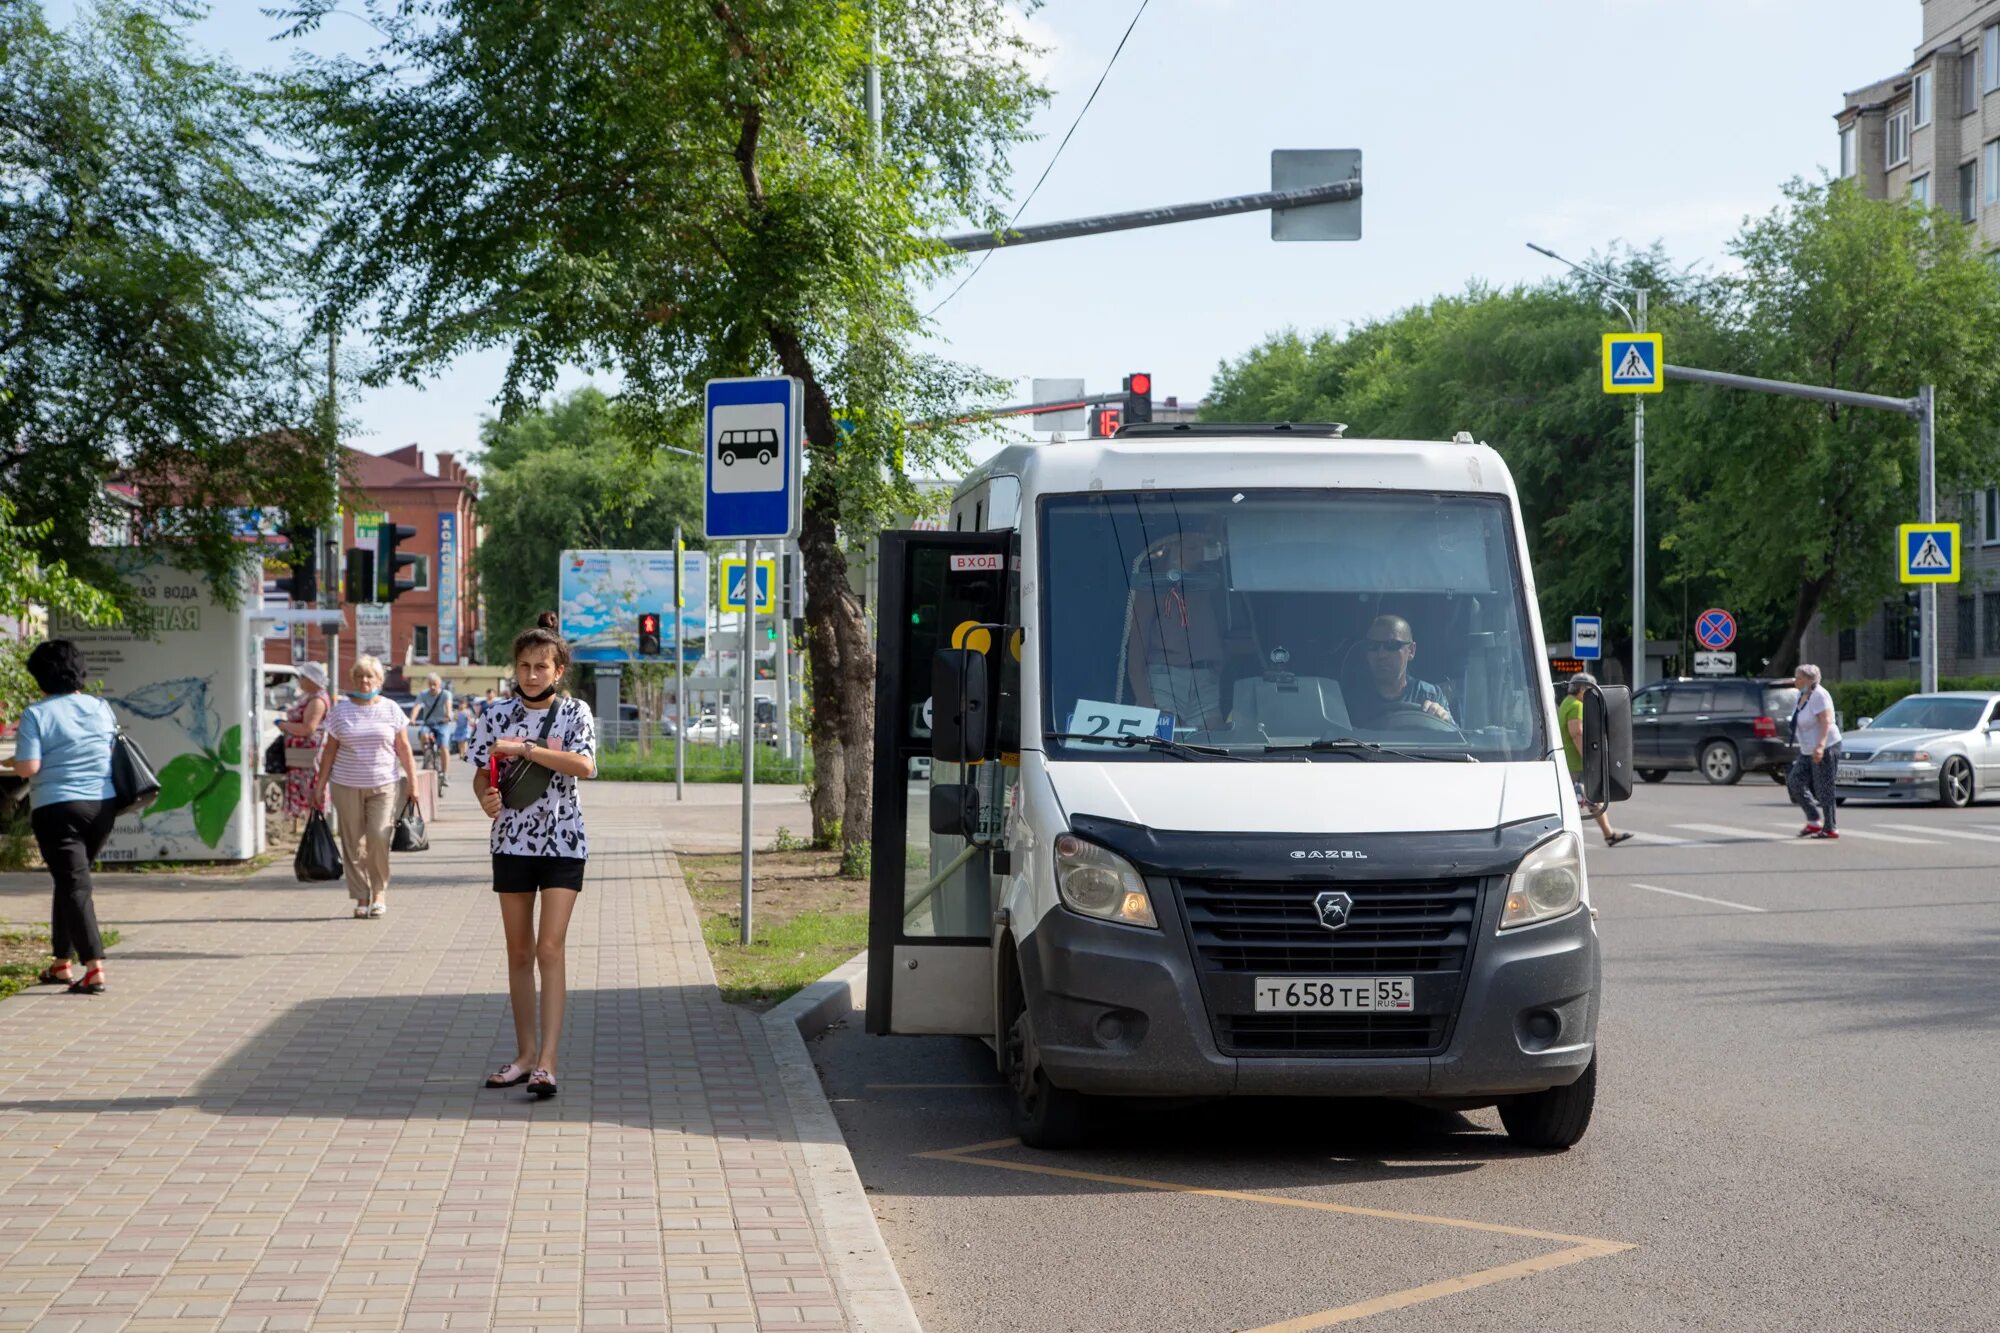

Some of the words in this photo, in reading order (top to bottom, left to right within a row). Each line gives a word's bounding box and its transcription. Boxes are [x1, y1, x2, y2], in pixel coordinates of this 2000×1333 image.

[1100, 410, 1119, 436] 16
[957, 557, 997, 568] ВХОД
[163, 586, 199, 600] ВОДА
[1080, 715, 1142, 748] 25
[1290, 850, 1368, 859] GAZEL
[1378, 981, 1403, 1000] 55
[1377, 1000, 1396, 1008] RUS
